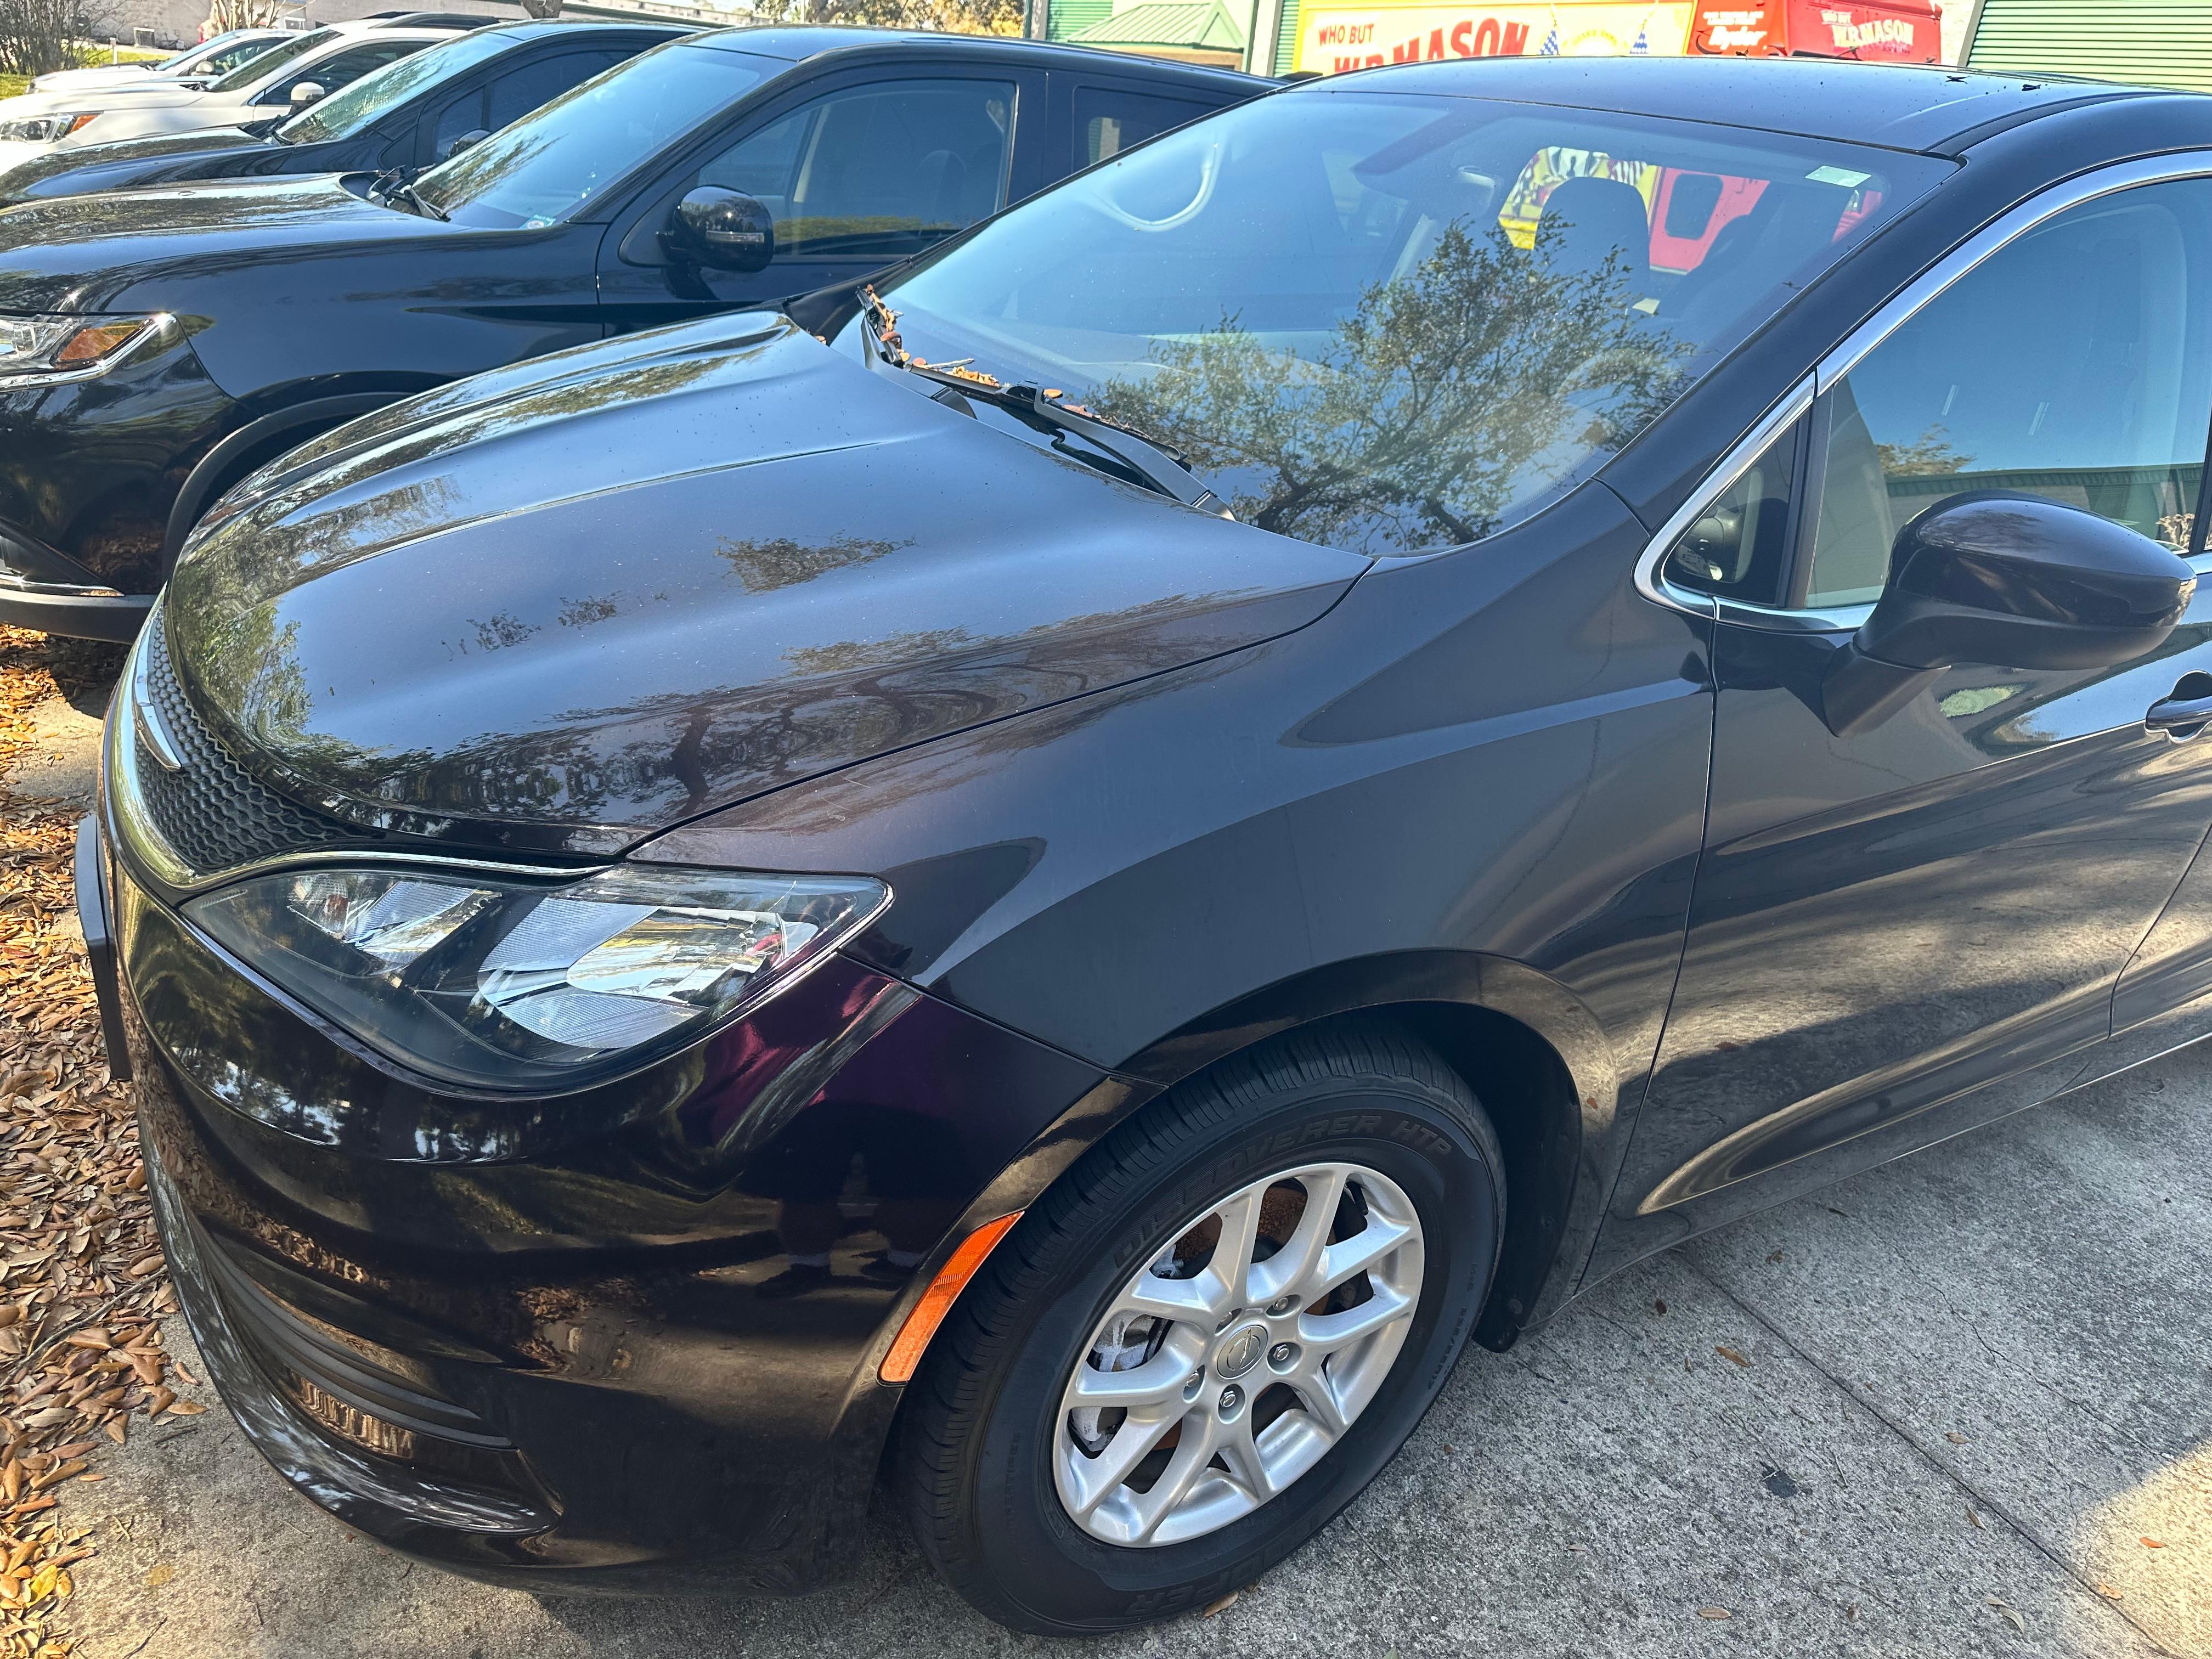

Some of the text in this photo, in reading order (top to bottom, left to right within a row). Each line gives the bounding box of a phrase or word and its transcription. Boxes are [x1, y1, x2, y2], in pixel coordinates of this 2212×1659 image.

[1319, 23, 1374, 46] WHO BUT
[1858, 19, 1914, 46] MASON
[1114, 1115, 1453, 1268] DISCOVERER HTP
